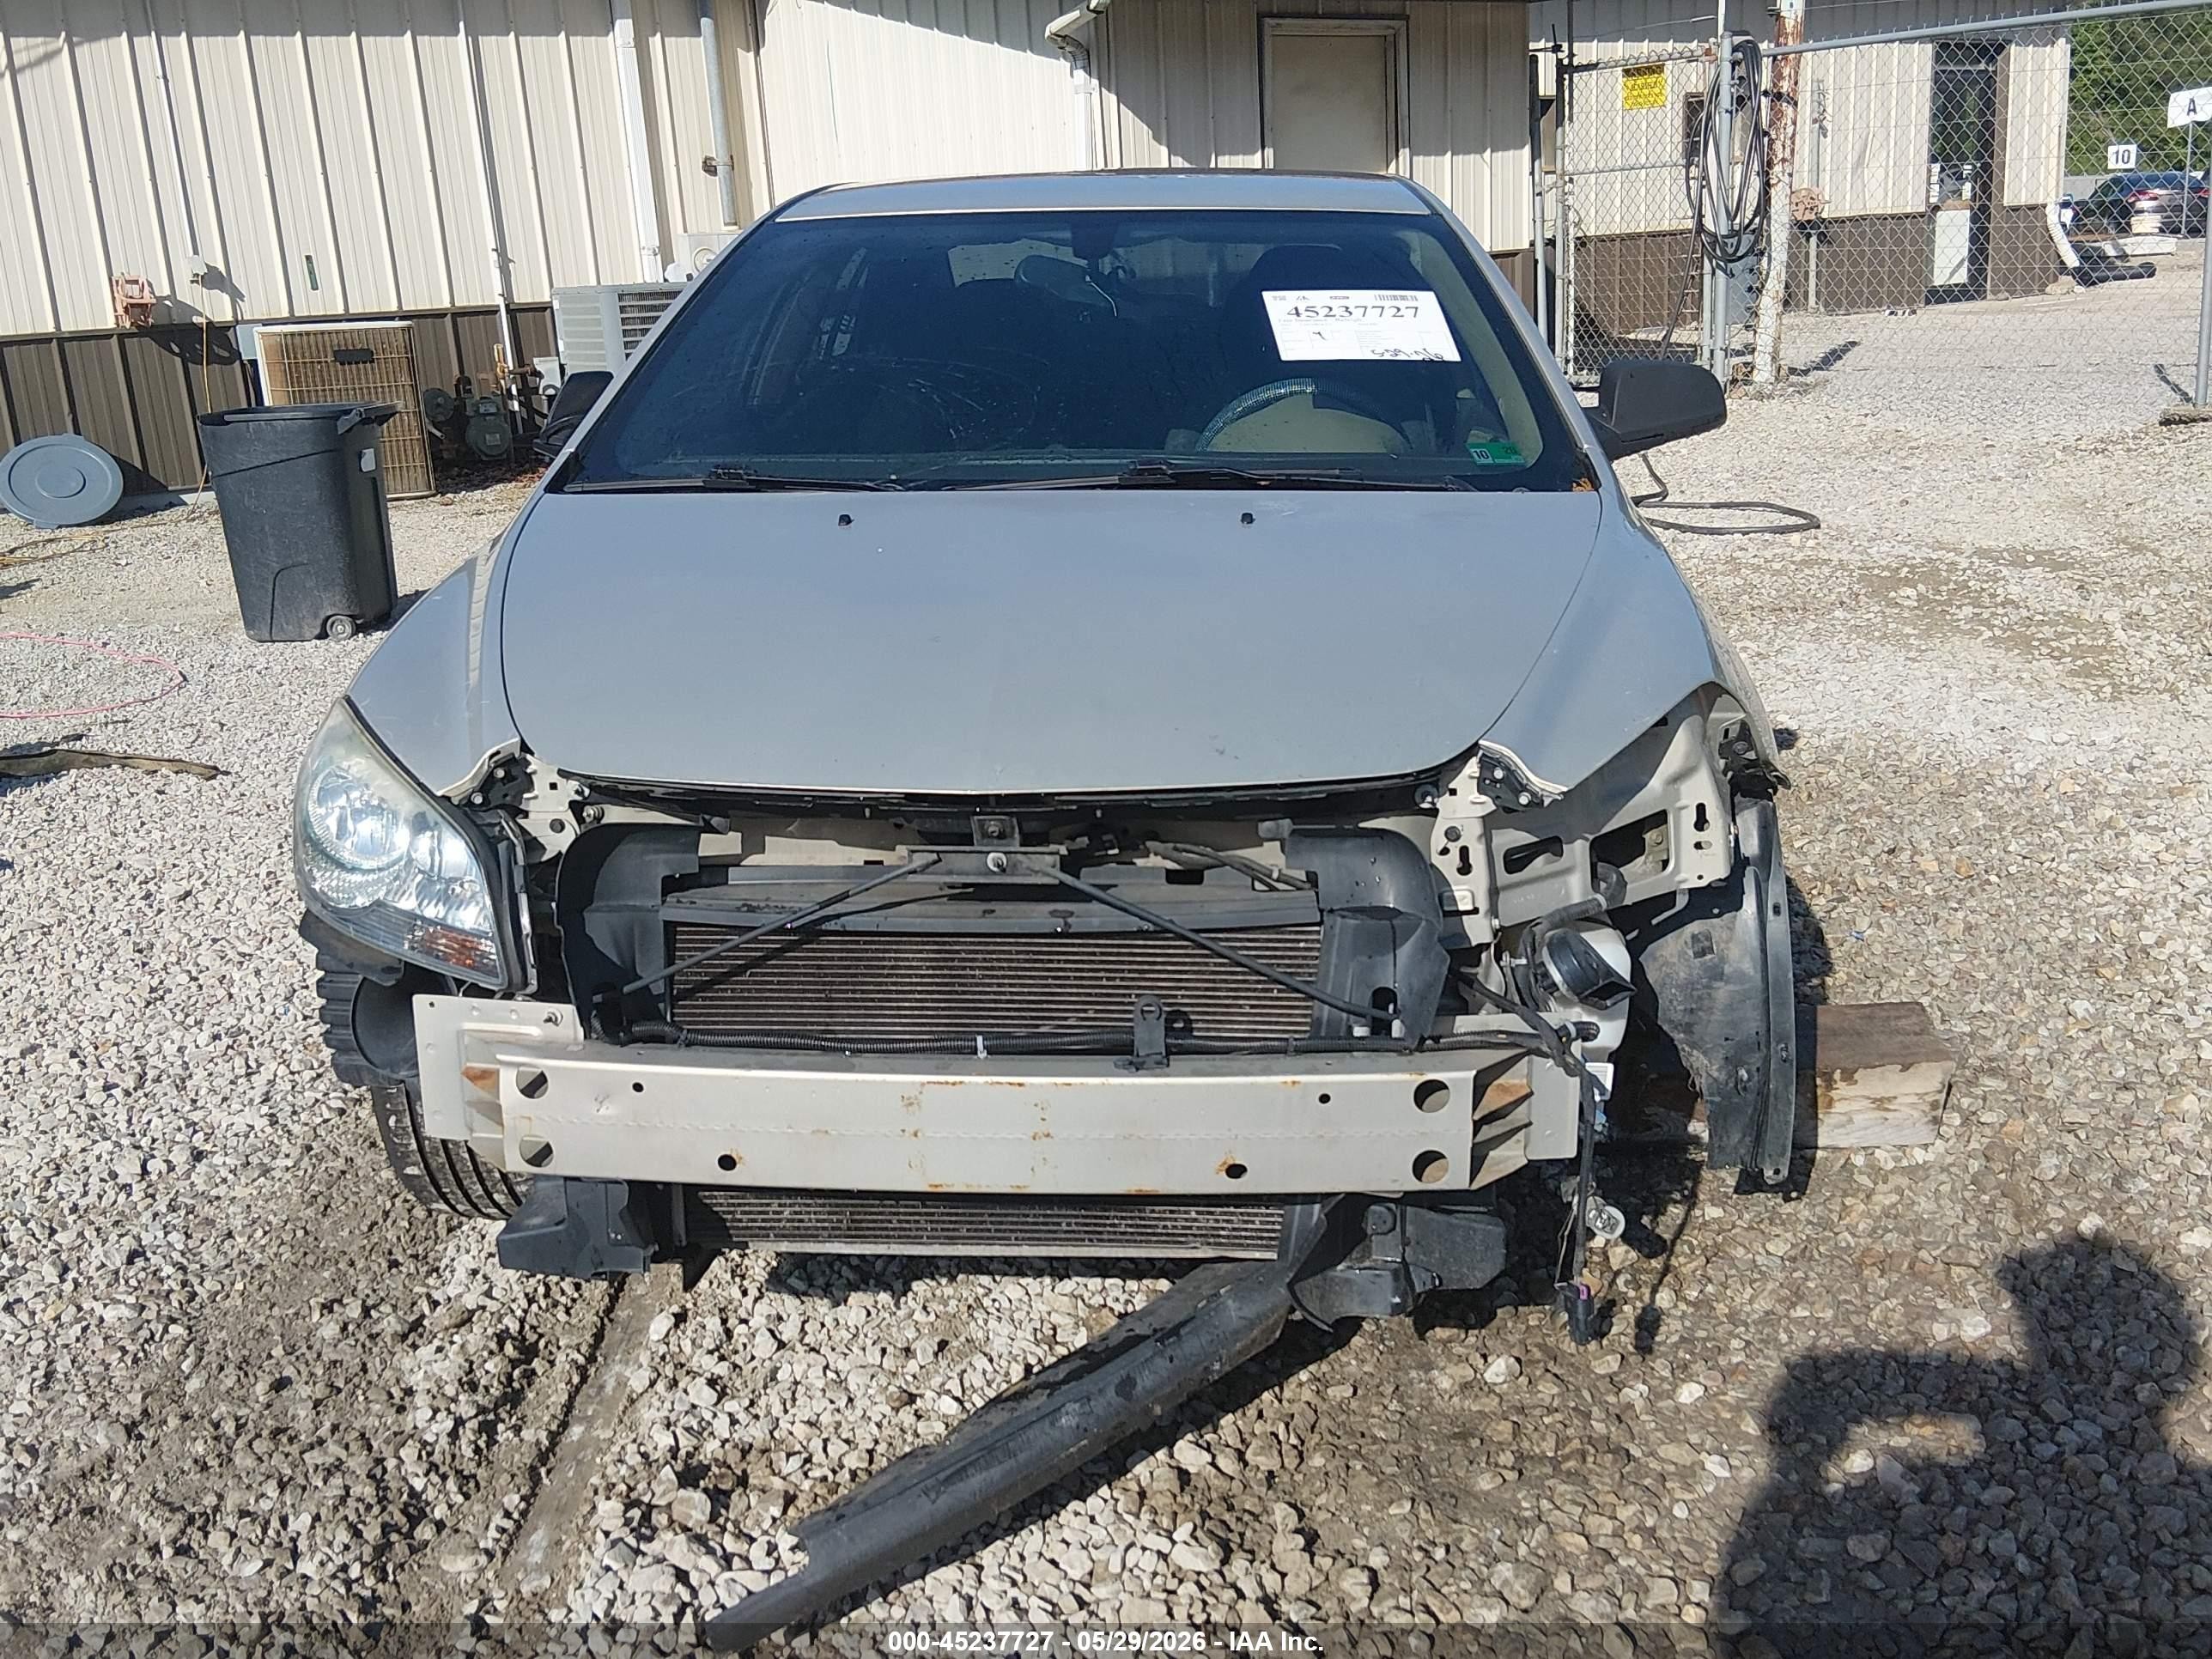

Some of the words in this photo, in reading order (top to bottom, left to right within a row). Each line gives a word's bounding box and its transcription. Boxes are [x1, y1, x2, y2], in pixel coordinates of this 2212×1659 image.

[2186, 96, 2197, 116] A
[2112, 149, 2131, 165] 10
[1287, 306, 1419, 319] 45237727
[1473, 450, 1490, 460] 10
